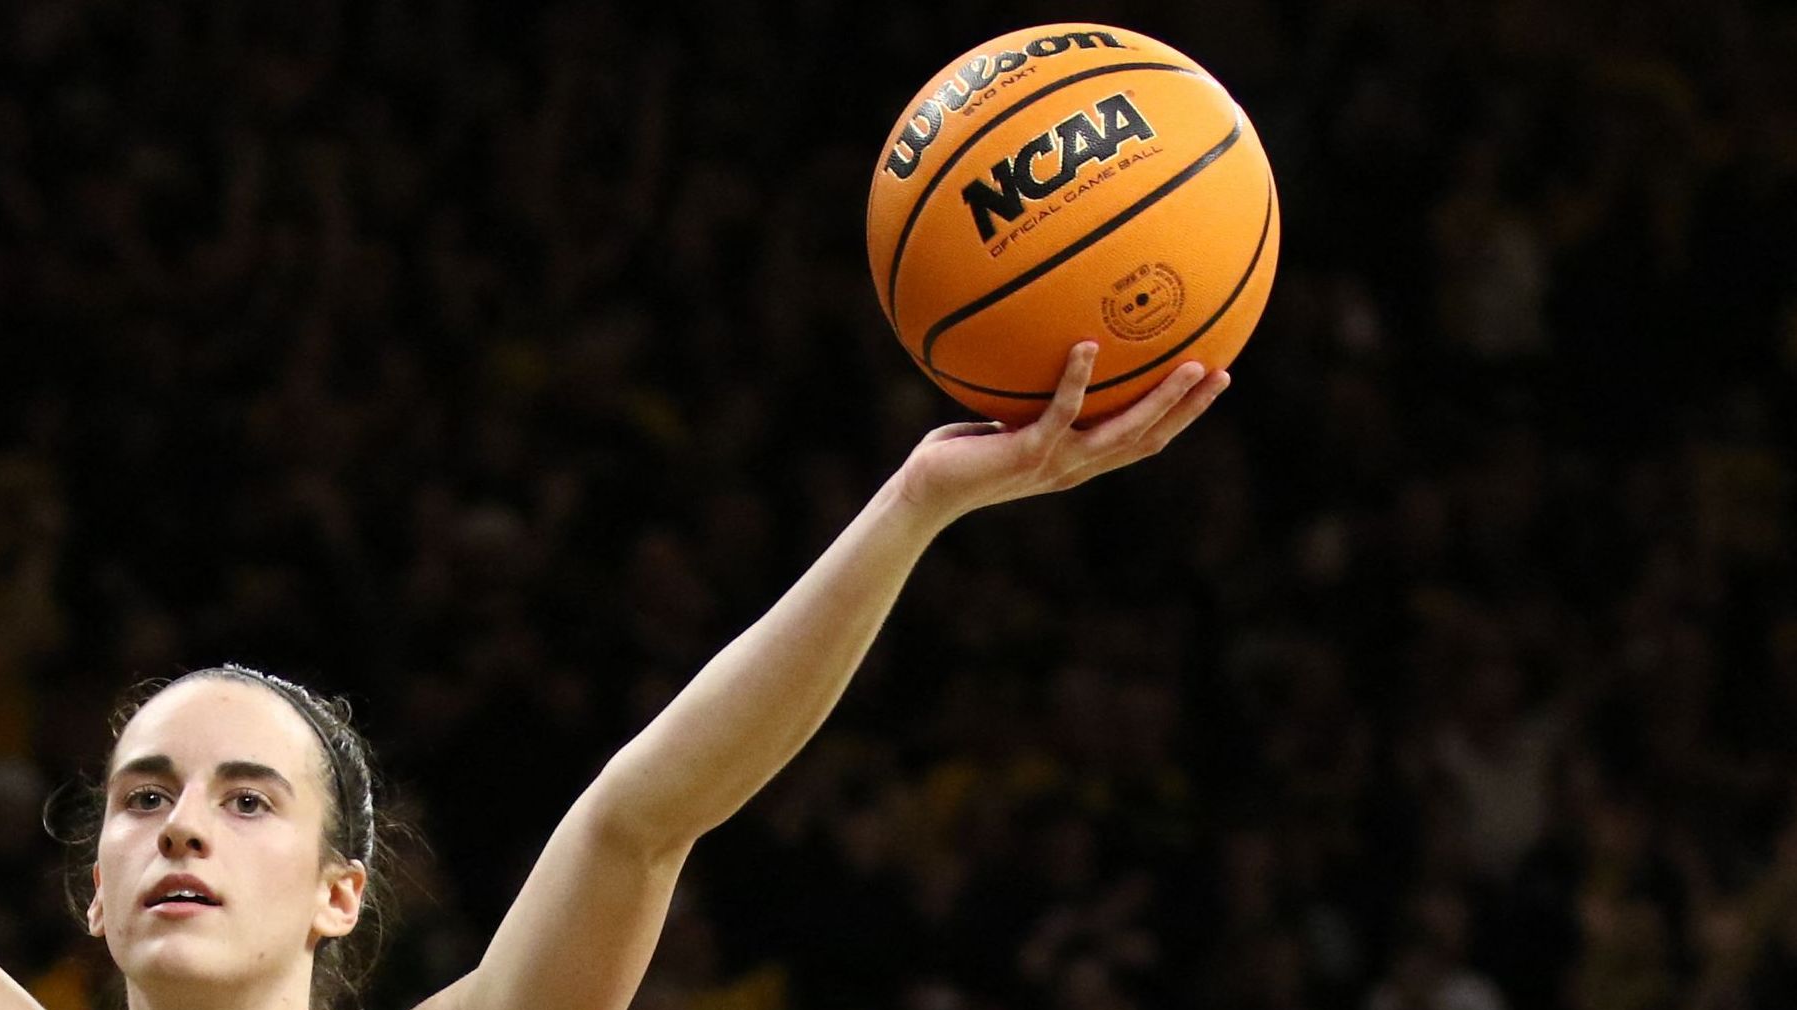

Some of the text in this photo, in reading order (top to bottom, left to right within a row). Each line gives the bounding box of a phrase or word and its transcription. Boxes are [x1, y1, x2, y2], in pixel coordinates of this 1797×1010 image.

[884, 31, 1127, 181] Wilson
[1002, 65, 1037, 88] NXT
[961, 92, 1157, 245] NCAA
[990, 146, 1163, 258] OFFICIAL GAME BALL
